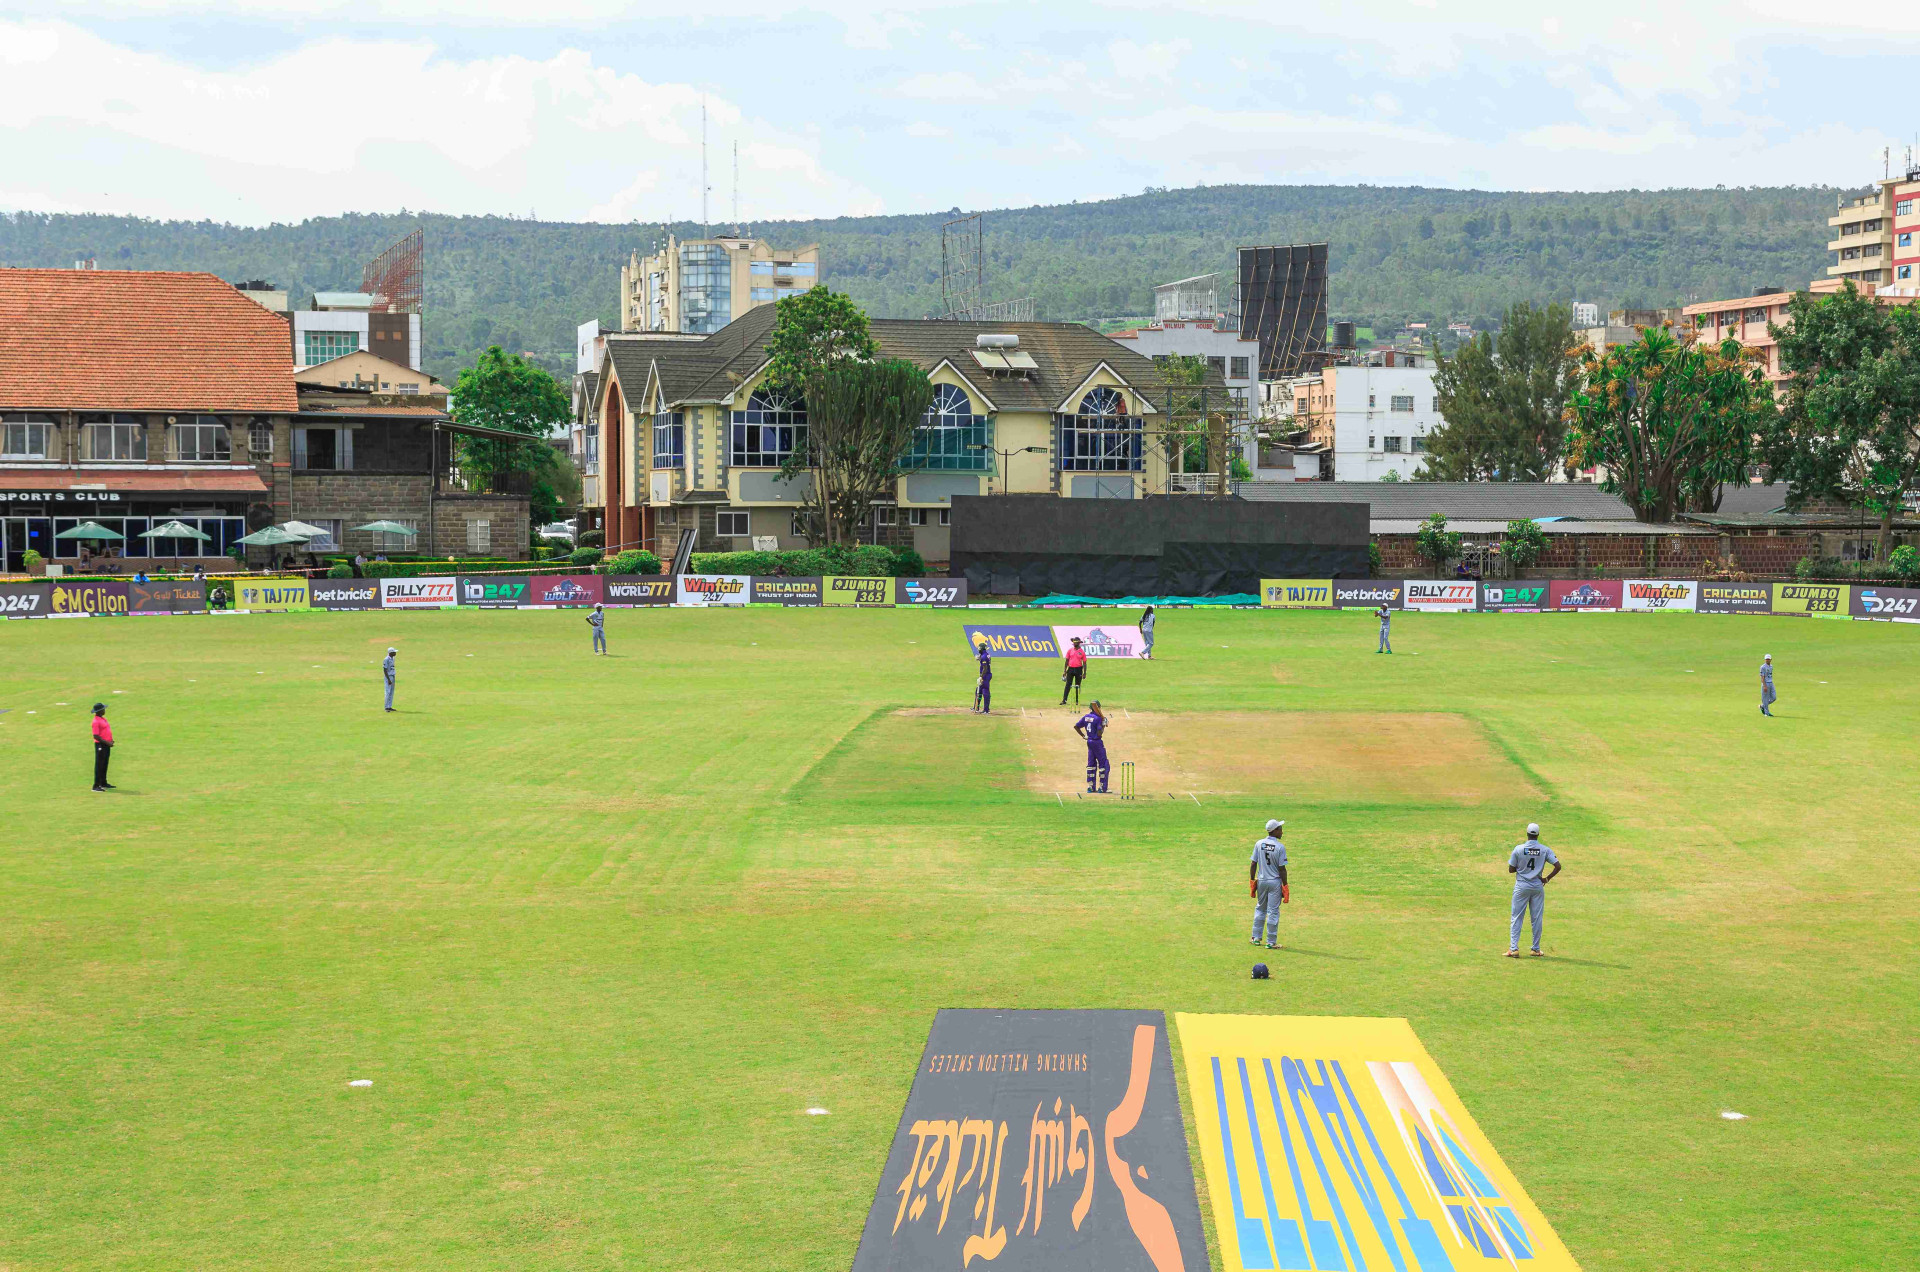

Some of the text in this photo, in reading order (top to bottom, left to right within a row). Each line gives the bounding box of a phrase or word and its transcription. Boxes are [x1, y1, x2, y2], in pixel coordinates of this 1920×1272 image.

[0, 493, 120, 501] SPORTS CLUB
[387, 583, 454, 597] BILLY777
[609, 582, 672, 597] WORLD777
[684, 578, 744, 593] Winfair
[842, 580, 884, 591] JUMBO
[1408, 585, 1475, 598] BILLY777
[1629, 584, 1690, 599] Winfair
[703, 591, 725, 602] 247
[859, 592, 882, 602] 365
[1793, 586, 1839, 599] JUMBO
[1648, 598, 1671, 607] 247
[1810, 600, 1836, 611] 365
[1265, 852, 1271, 866] 5
[1527, 857, 1535, 871] 4
[929, 1054, 1088, 1073] SHARING MILLION SMILES
